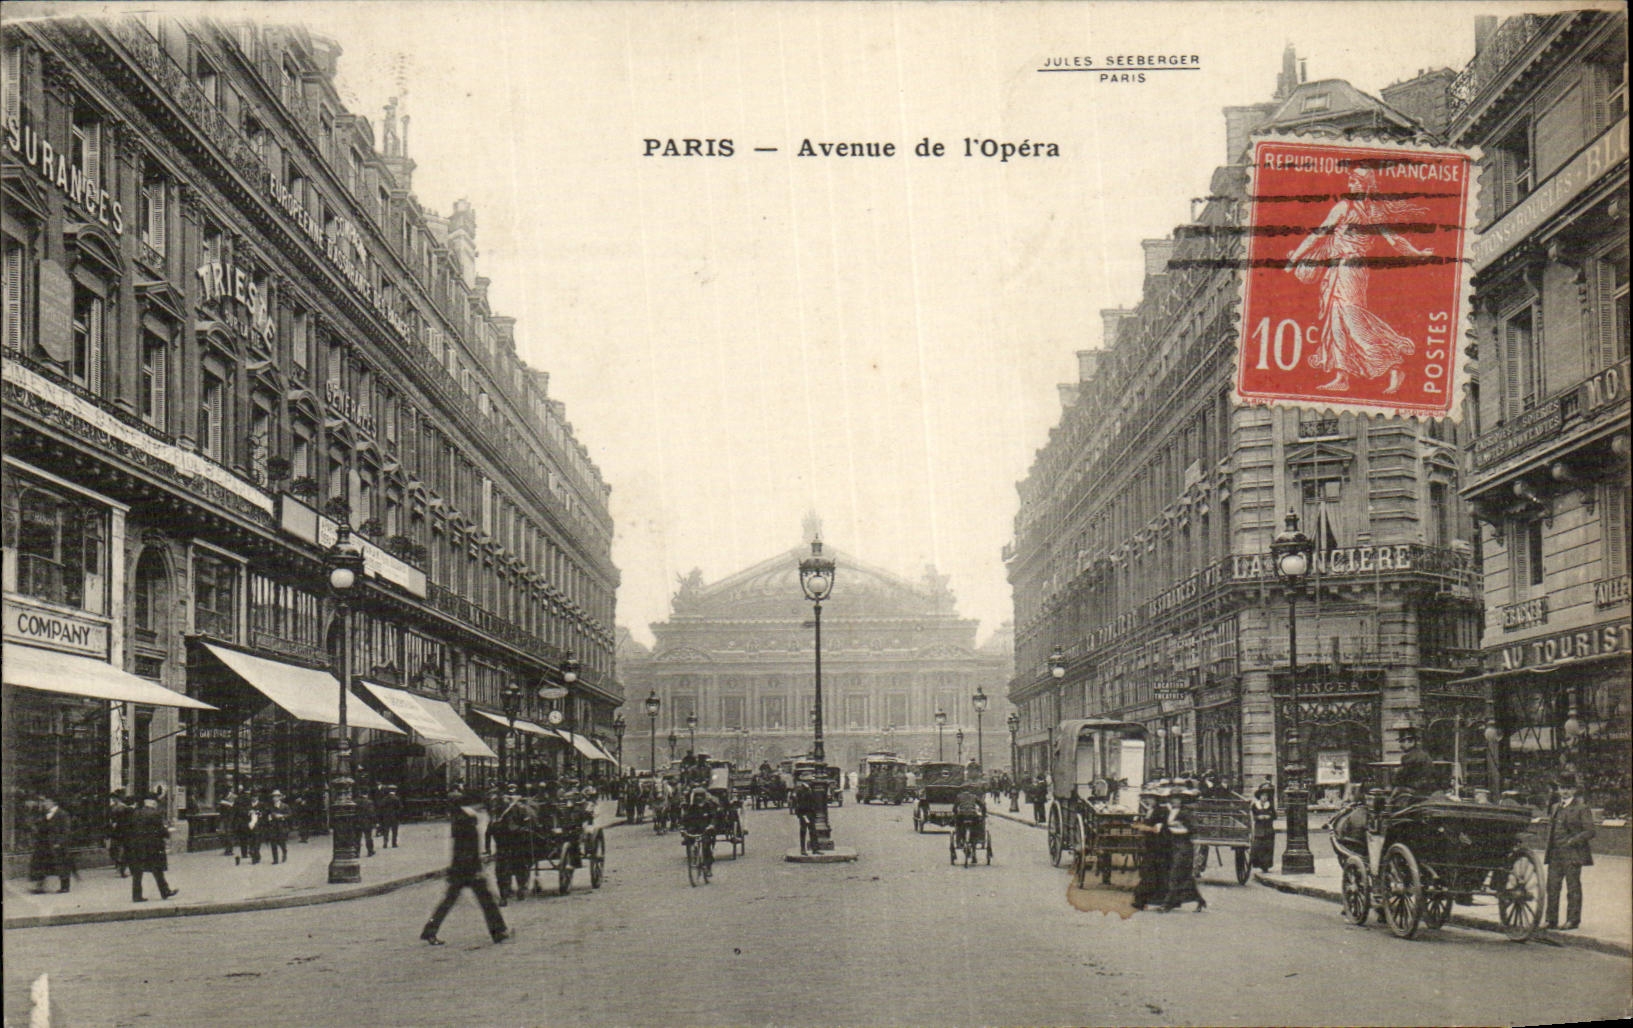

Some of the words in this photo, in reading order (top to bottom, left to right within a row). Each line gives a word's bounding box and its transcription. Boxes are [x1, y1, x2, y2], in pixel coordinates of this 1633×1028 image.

[1264, 153, 1353, 176] REPUBLIQUE
[1423, 310, 1449, 394] POSTES
[1232, 555, 1261, 579] LA
[17, 613, 91, 646] COMPANY
[1500, 646, 1524, 671] AU
[1296, 681, 1361, 694] SINGER
